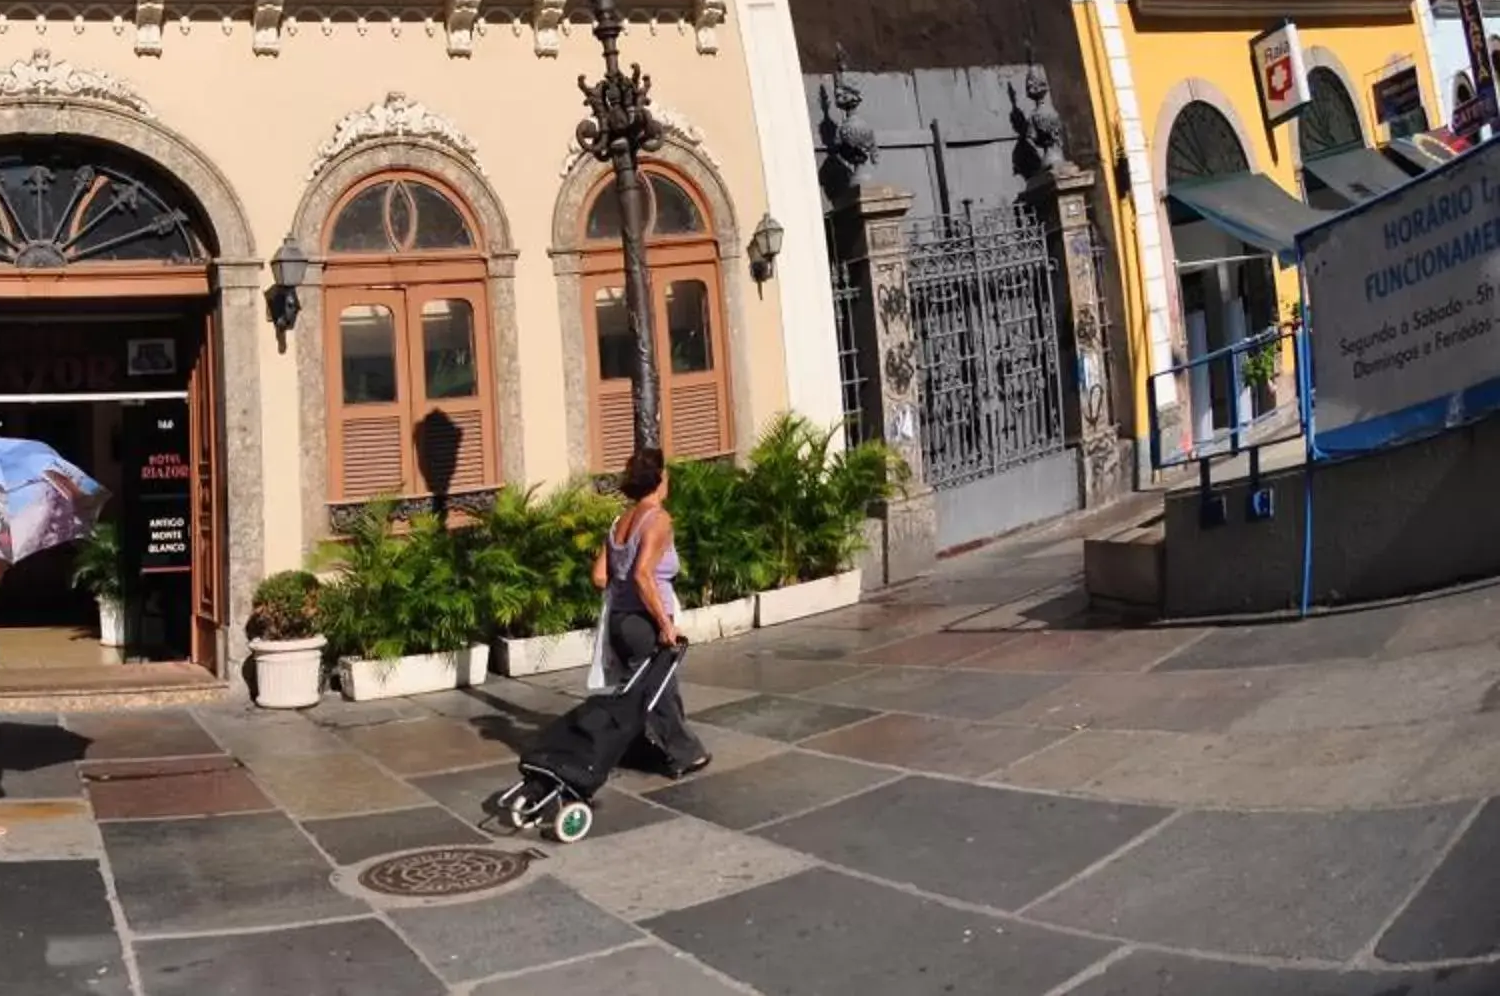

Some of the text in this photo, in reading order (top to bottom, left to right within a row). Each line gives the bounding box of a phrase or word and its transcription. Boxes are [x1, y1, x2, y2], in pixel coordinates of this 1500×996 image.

[1265, 40, 1290, 63] Raia
[1340, 321, 1397, 357] Segunda
[1353, 346, 1419, 379] Domingos
[1435, 318, 1492, 351] Feriados
[148, 455, 182, 465] HOTEL
[141, 466, 190, 479] RIAZOR
[149, 518, 185, 528] ANTICO
[151, 530, 182, 540] MONTE
[147, 543, 185, 553] BLANCO
